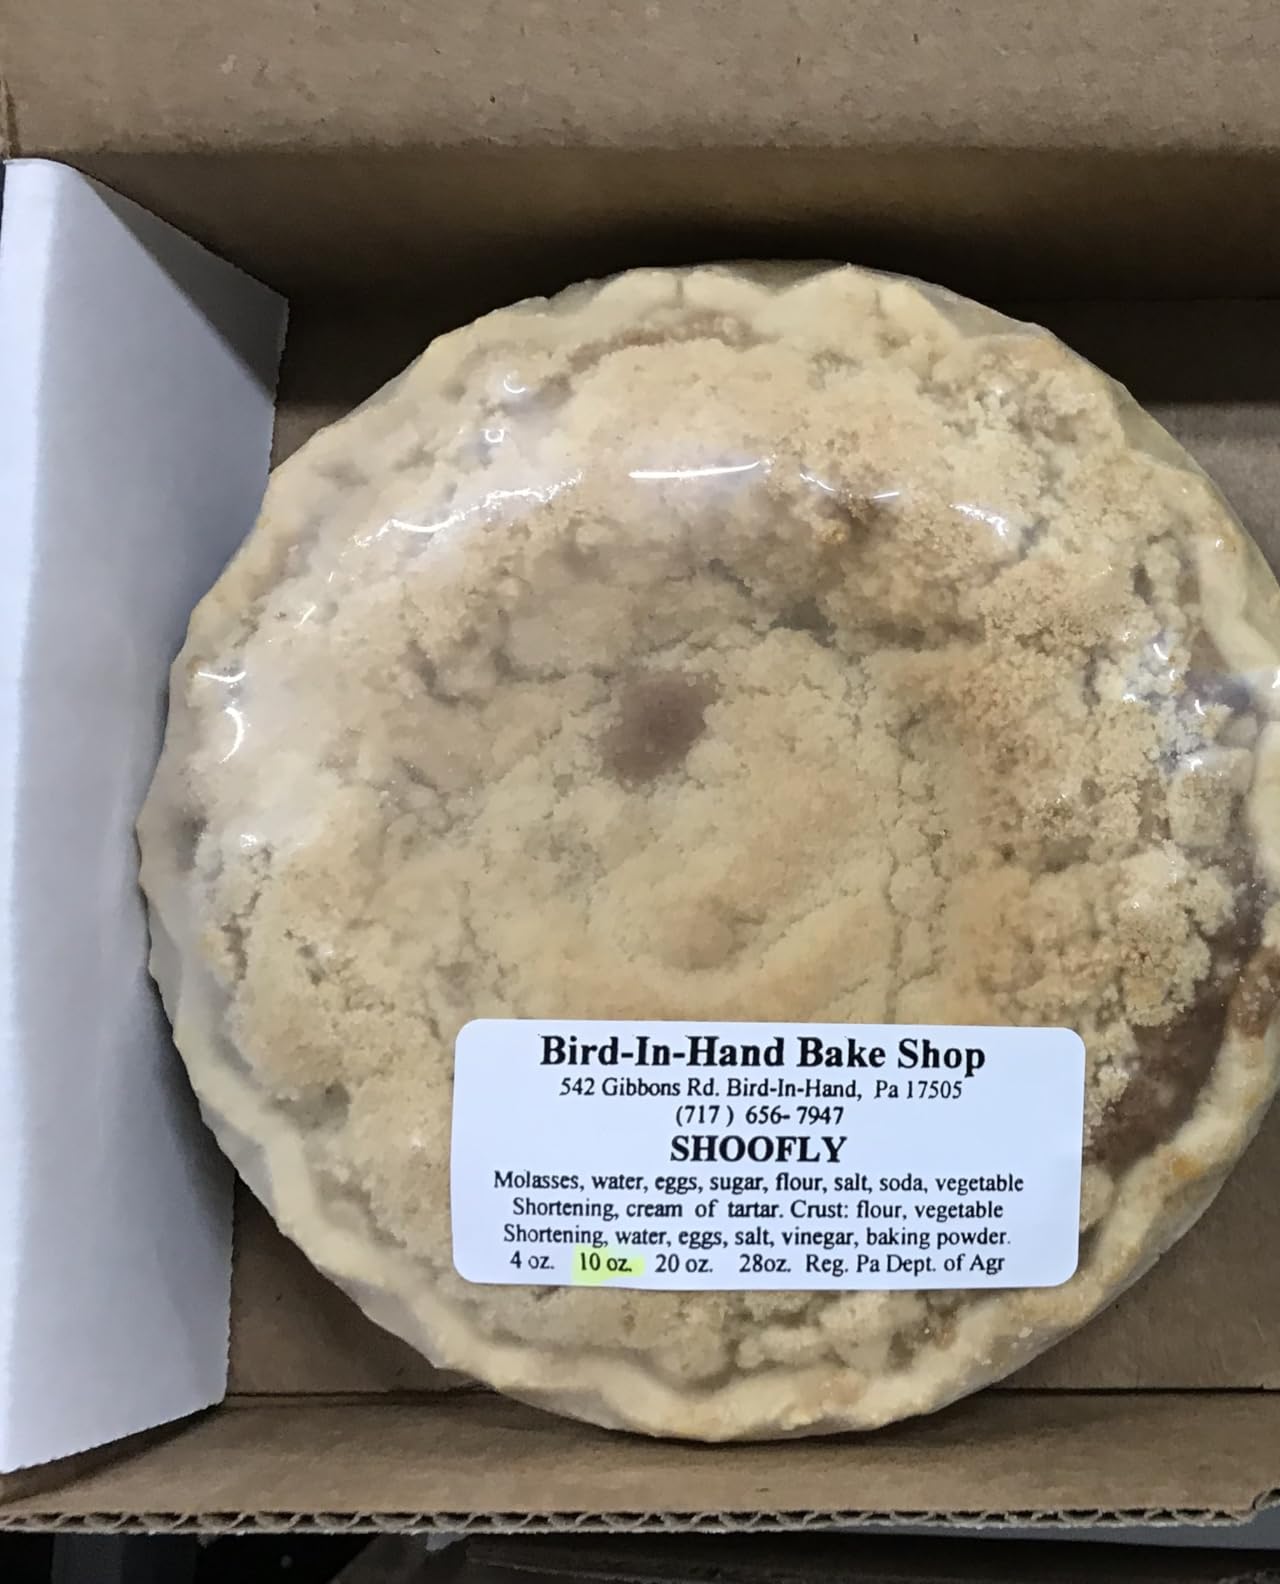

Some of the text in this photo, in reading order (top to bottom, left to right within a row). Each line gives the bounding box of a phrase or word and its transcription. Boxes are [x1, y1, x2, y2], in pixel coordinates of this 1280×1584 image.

[539, 1035, 986, 1079] Bird-In-Hand Bake Shop
[559, 1076, 963, 1102] 542 Gibbons Rd. Bird-In-Hand, Pa 17505
[670, 1134, 848, 1164] SHOOFLY
[494, 1170, 1024, 1197] Molasses, water, eggs, sugar, flour, salt, soda, vegetable
[512, 1196, 1004, 1223] Shortening, cream of tartar. Crust: flour, vegetable
[503, 1223, 1011, 1251] Shortening, water, eggs, salt, vinegar, baking powder.
[509, 1250, 1006, 1278] 4 oz. 10 oz. 20 oz. 28oz. Reg. Pa Dept. of Agr
